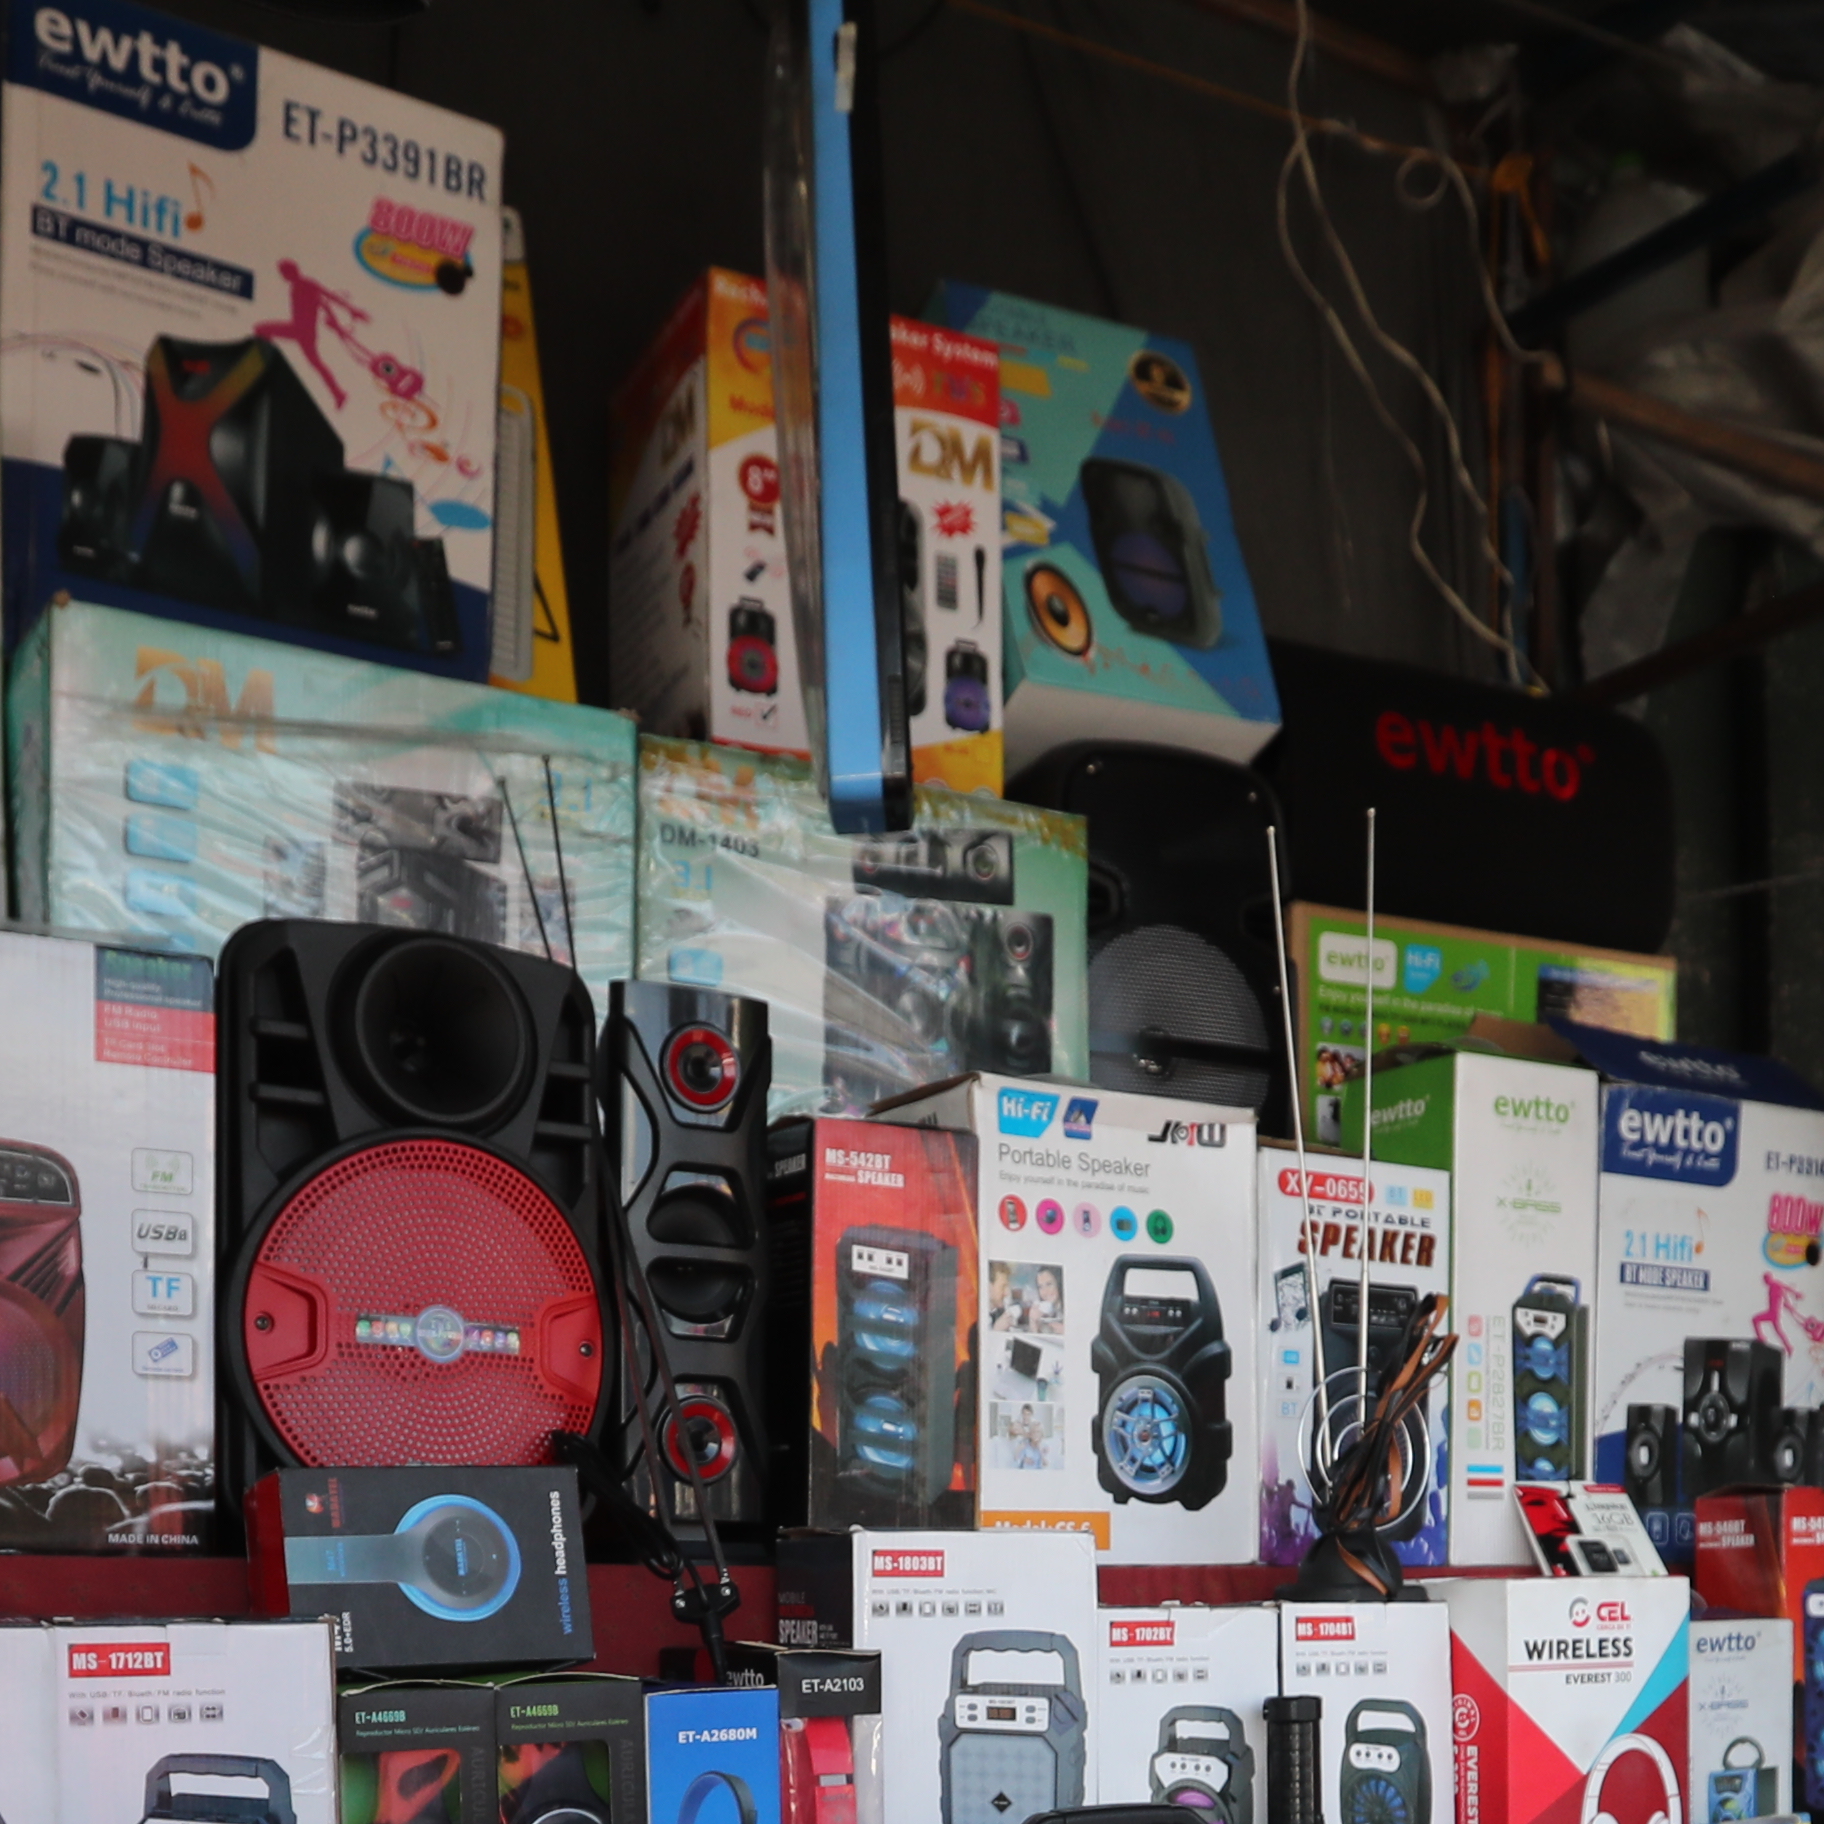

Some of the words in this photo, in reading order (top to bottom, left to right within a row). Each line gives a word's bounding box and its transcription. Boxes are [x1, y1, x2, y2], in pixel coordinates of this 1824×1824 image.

[34, 4, 231, 105] ewtto
[282, 100, 487, 201] ET-P3391BR
[40, 161, 87, 209] 2.1
[104, 178, 182, 239] Hifi
[35, 209, 72, 239] BT
[76, 220, 142, 262] mode
[147, 242, 244, 295] Speaker
[931, 329, 998, 369] System
[907, 418, 995, 492] DM
[1377, 711, 1579, 800] ewtto
[126, 1006, 158, 1019] Radio
[1001, 1096, 1051, 1122] Hi-Fi
[1495, 1093, 1570, 1125] ewtto
[1618, 1108, 1726, 1151] ewtto
[825, 1148, 892, 1170] MS-542BT
[998, 1145, 1071, 1170] Portable
[1077, 1153, 1150, 1177] Speaker
[857, 1169, 904, 1188] SPEAKER
[1298, 1220, 1436, 1268] SPEAKER
[1655, 1233, 1693, 1262] Hifi
[147, 1276, 181, 1299] TF
[1625, 1265, 1637, 1283] BT
[1639, 1266, 1664, 1286] MODE
[1666, 1269, 1706, 1289] SPEAKER
[107, 1532, 145, 1546] MADE
[148, 1533, 161, 1546] IN
[164, 1533, 199, 1546] CHINA
[549, 1491, 567, 1576] headphones
[1722, 1534, 1755, 1547] SPEAKER
[874, 1555, 943, 1573] MS-1803BT
[558, 1577, 573, 1635] wireless
[1597, 1602, 1631, 1622] CEL
[778, 1619, 819, 1647] SPEAKER
[1111, 1626, 1173, 1646] MS-1702BT
[1297, 1620, 1354, 1638] MS-1704BT
[1524, 1637, 1633, 1661] WIRELESS
[1696, 1631, 1756, 1654] ewtto
[801, 1677, 865, 1694] ET-A2103
[1565, 1673, 1611, 1685] EVEREST
[1615, 1671, 1632, 1683] 300
[355, 1711, 406, 1724] ET-A4669B
[510, 1706, 559, 1717] ET-A4669B
[678, 1728, 757, 1744] ET-A2680M
